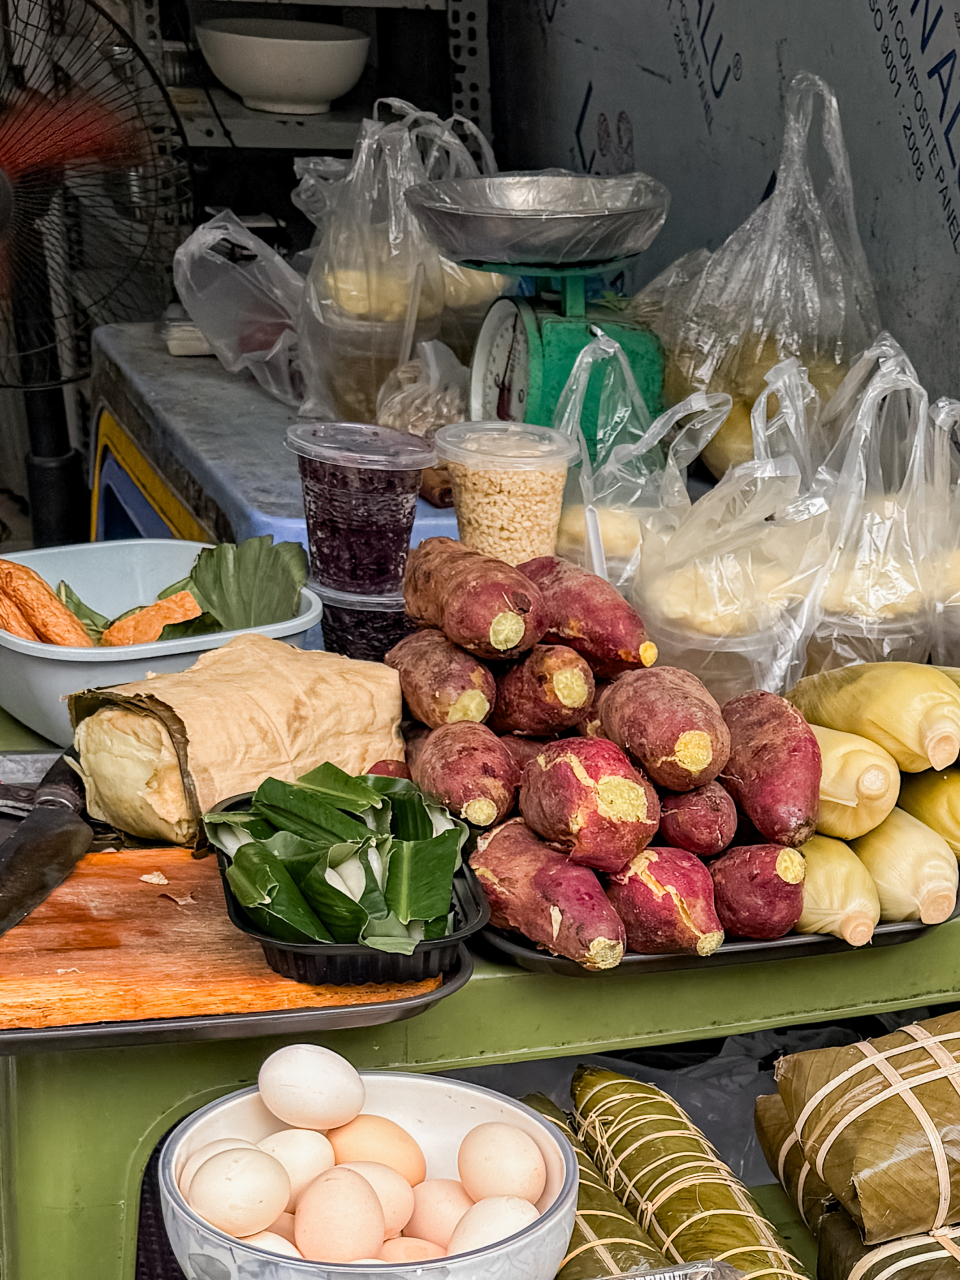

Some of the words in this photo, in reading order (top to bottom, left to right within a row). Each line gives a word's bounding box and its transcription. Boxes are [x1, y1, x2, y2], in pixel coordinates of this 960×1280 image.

[881, 35, 902, 98] 9001
[903, 116, 925, 182] 2008
[894, 20, 938, 167] COMPOSITE
[935, 166, 960, 254] PANEL
